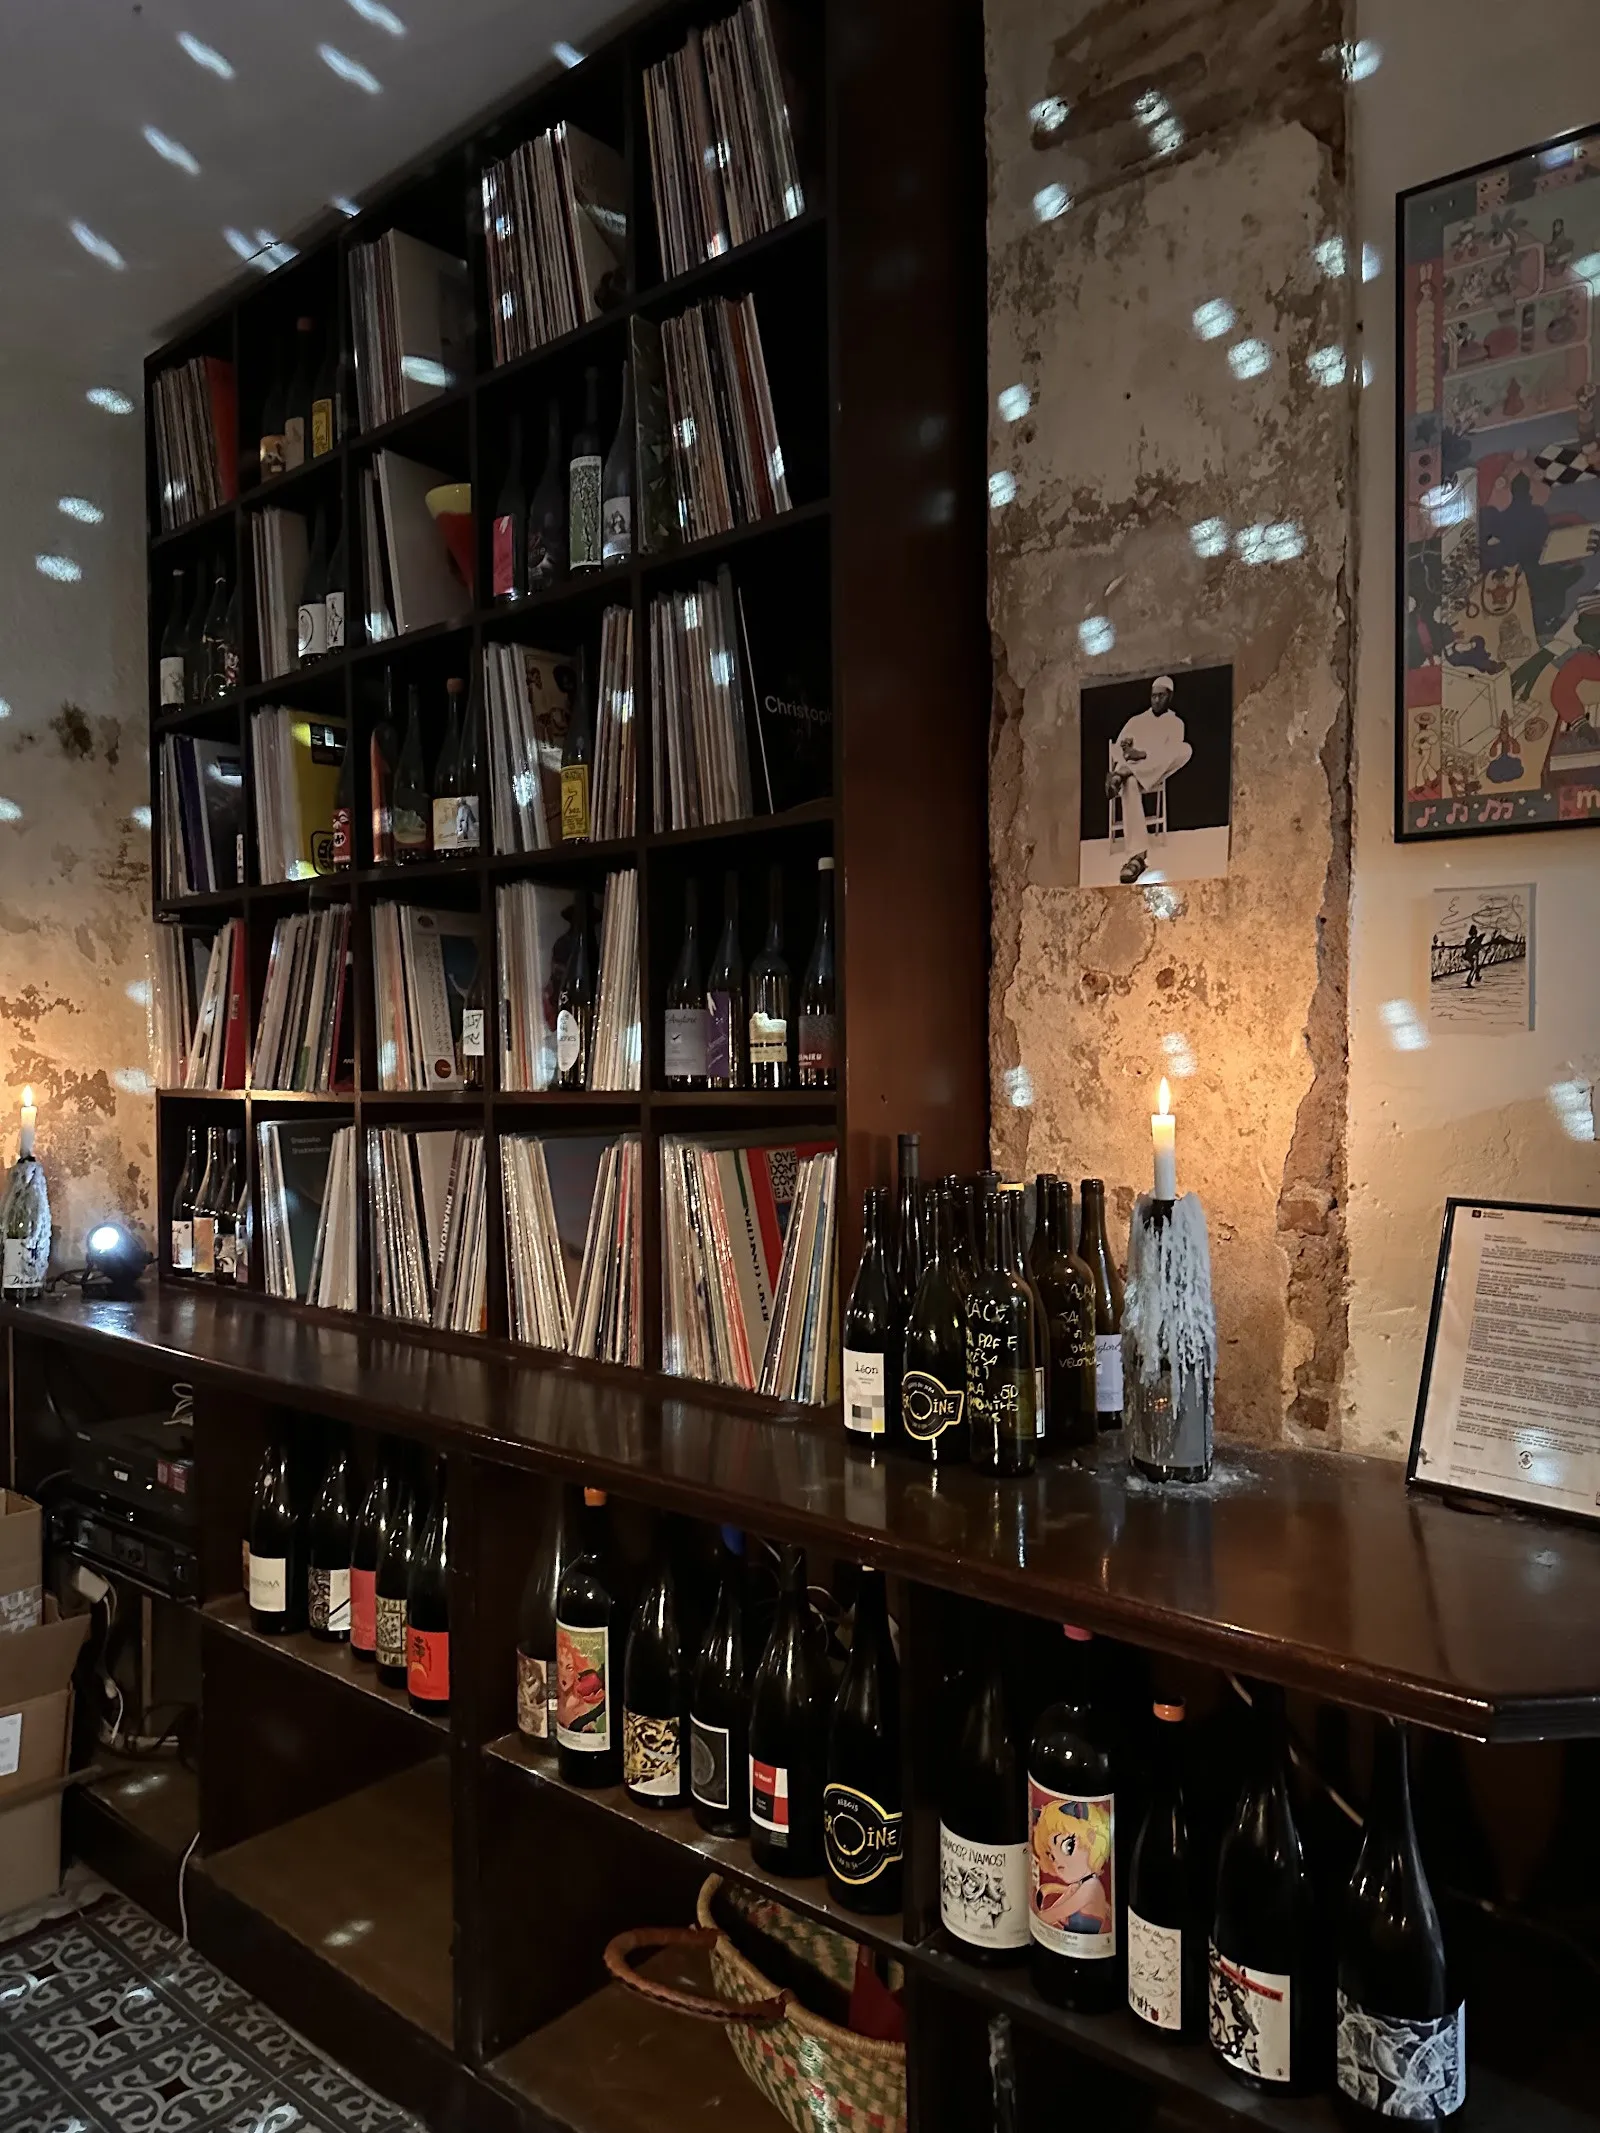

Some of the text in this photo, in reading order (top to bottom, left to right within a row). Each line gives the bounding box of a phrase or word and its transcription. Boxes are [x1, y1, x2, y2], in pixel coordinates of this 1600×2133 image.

[767, 1151, 796, 1164] LOVE
[771, 1175, 797, 1187] COM
[774, 1186, 795, 1199] EAS
